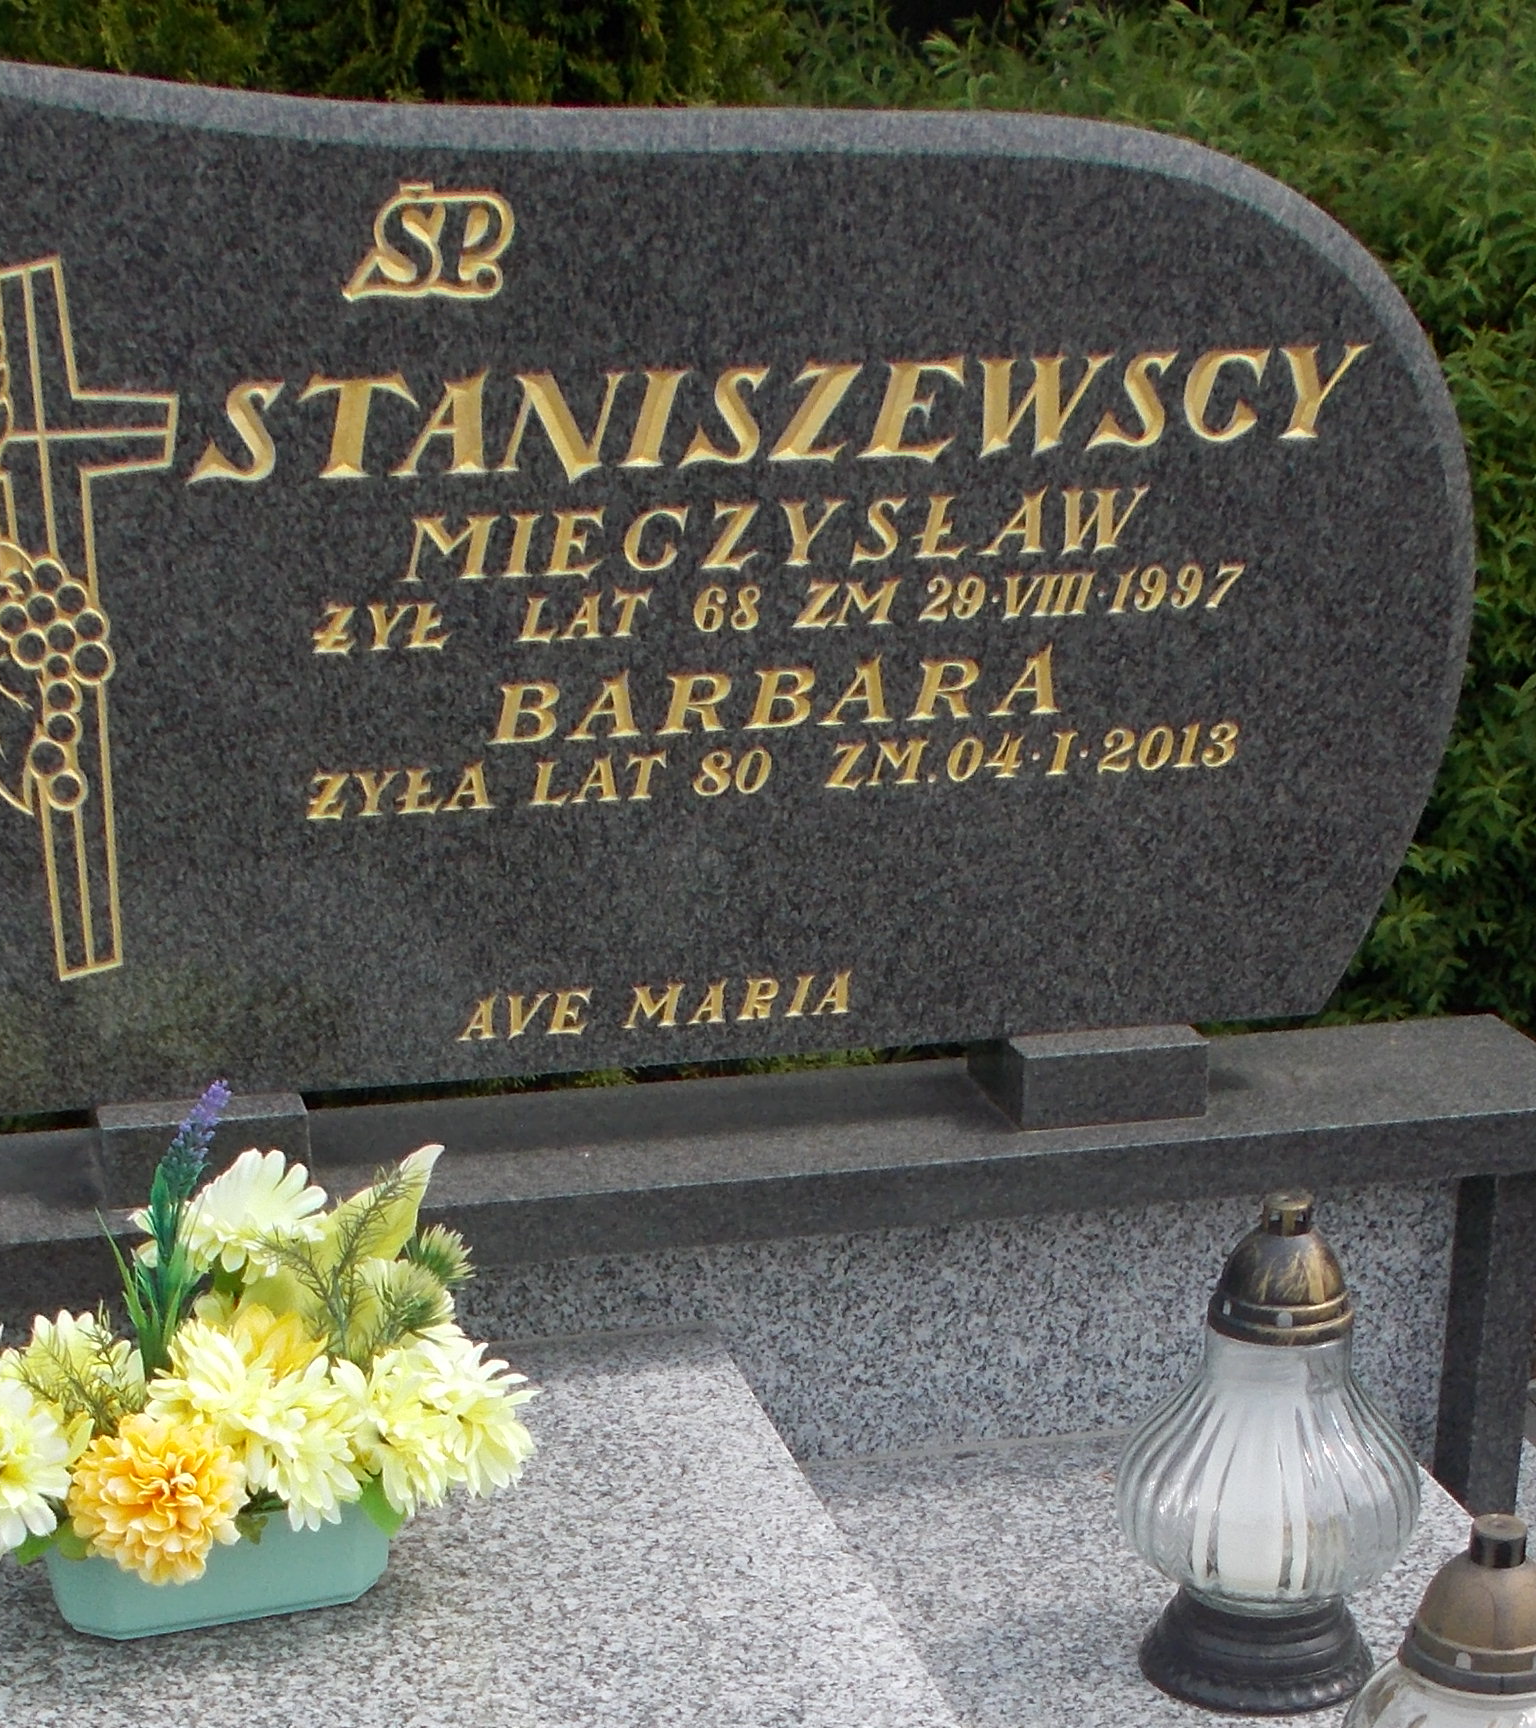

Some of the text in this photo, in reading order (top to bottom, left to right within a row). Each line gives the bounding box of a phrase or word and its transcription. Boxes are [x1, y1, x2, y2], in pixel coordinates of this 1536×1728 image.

[185, 343, 1371, 484] STANISZEWSCY
[401, 484, 1151, 583] MIECZYSŁAW
[517, 587, 652, 643] LAT
[693, 585, 762, 633] 68
[792, 575, 900, 629] ZM
[487, 642, 1061, 745] BARBARA
[528, 750, 668, 808] LAT
[693, 749, 773, 797] 80
[458, 968, 853, 1042] AVE MARIA
